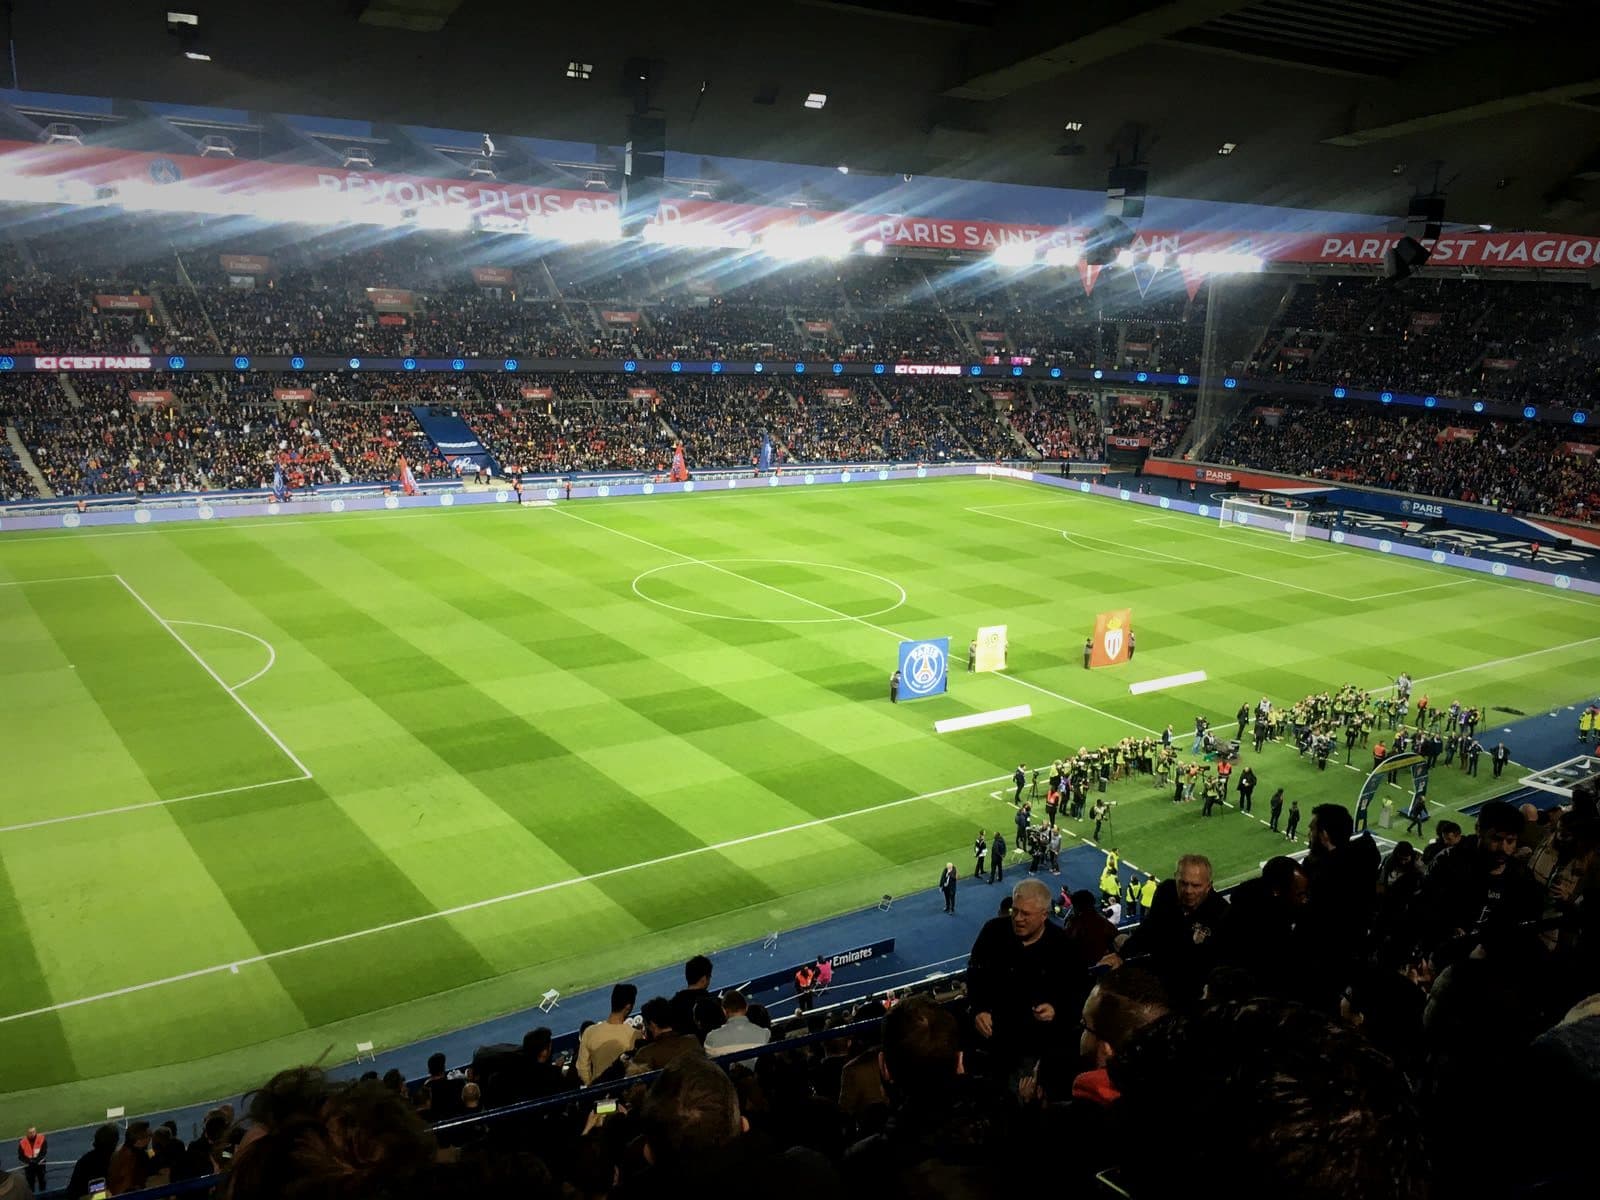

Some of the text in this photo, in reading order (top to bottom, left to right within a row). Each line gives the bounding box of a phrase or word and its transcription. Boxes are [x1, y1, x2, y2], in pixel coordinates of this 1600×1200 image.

[479, 186, 562, 215] PLUS
[878, 220, 956, 244] PARIS
[1320, 239, 1399, 258] PARI
[35, 357, 152, 369] ICI C'EST PARIS
[1206, 470, 1232, 480] PARIS
[1413, 502, 1443, 514] PARIS
[832, 948, 873, 967] Emirates
